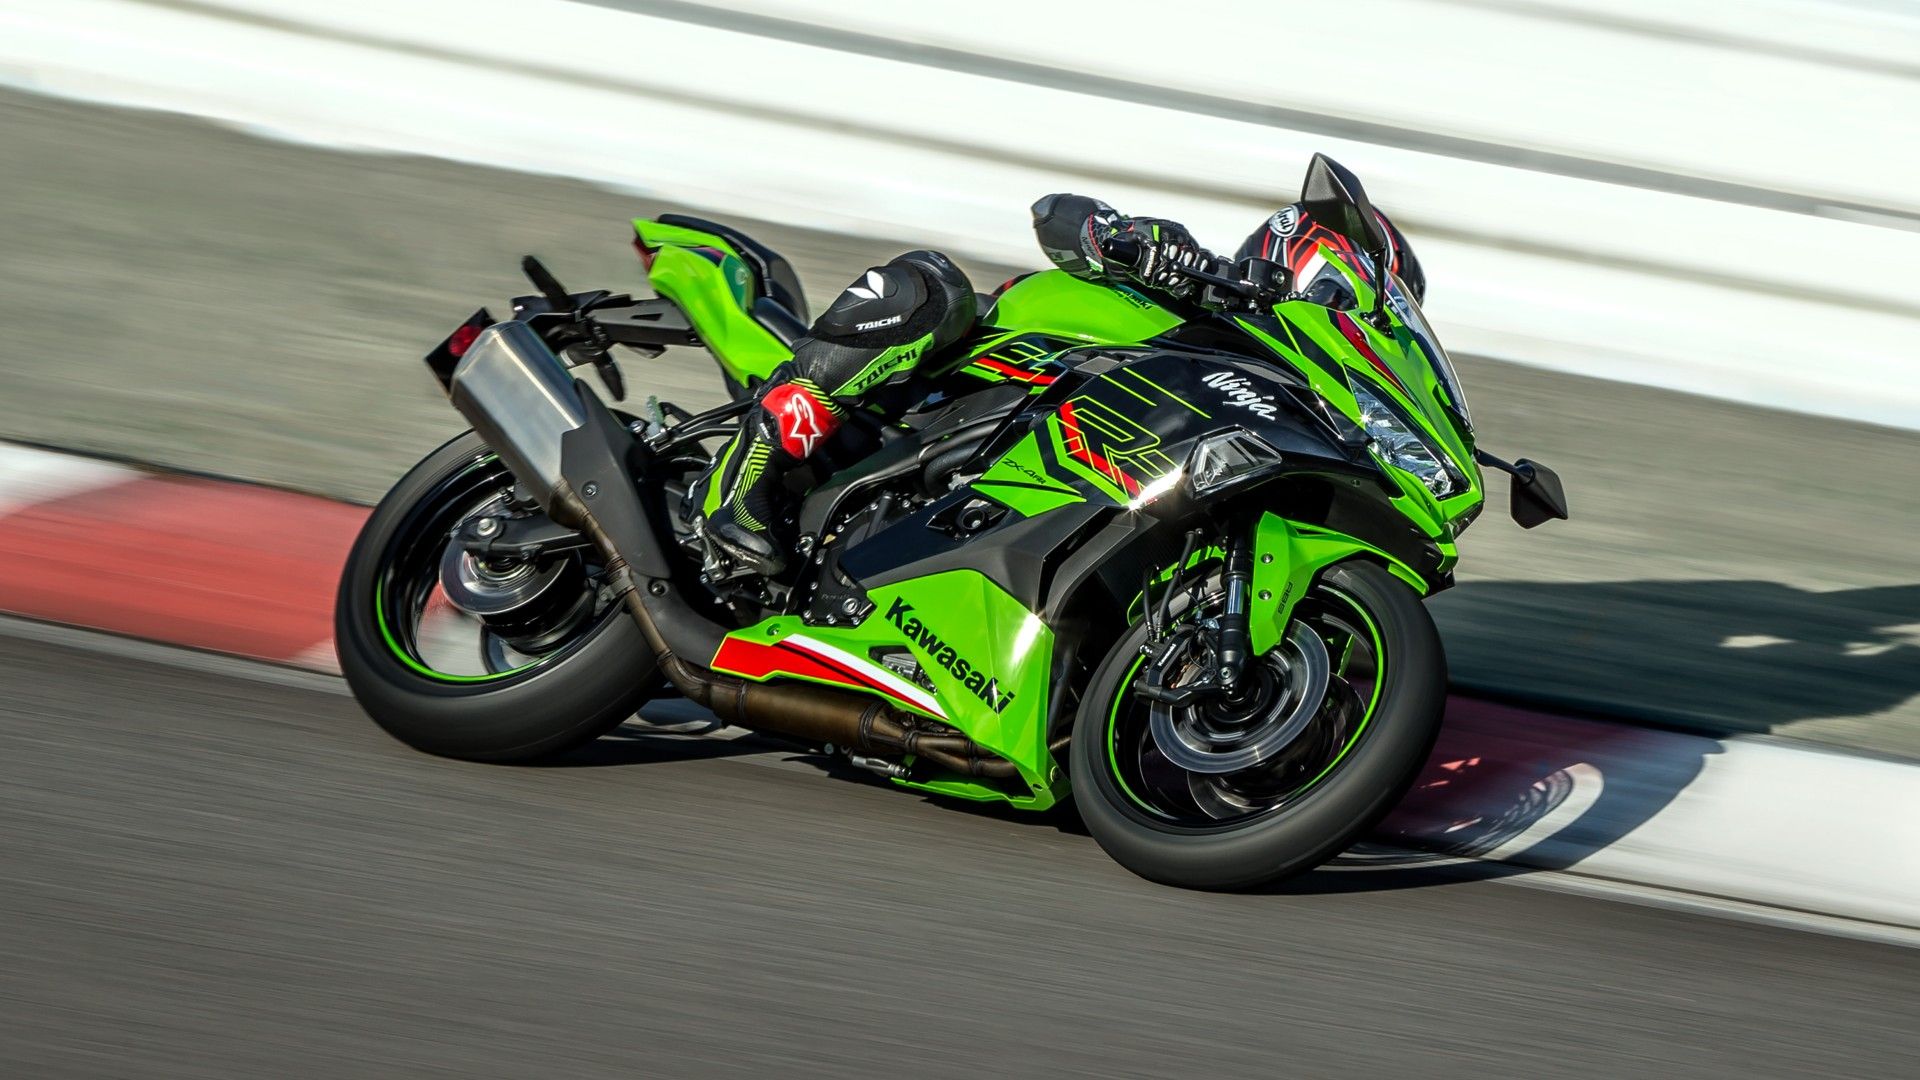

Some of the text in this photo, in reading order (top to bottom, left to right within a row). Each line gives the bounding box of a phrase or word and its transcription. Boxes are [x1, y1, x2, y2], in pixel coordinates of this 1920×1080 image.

[855, 315, 902, 331] TAICHI
[853, 349, 918, 391] TAICHI
[1203, 371, 1276, 421] Ninja
[884, 596, 1016, 715] Kawasaki
